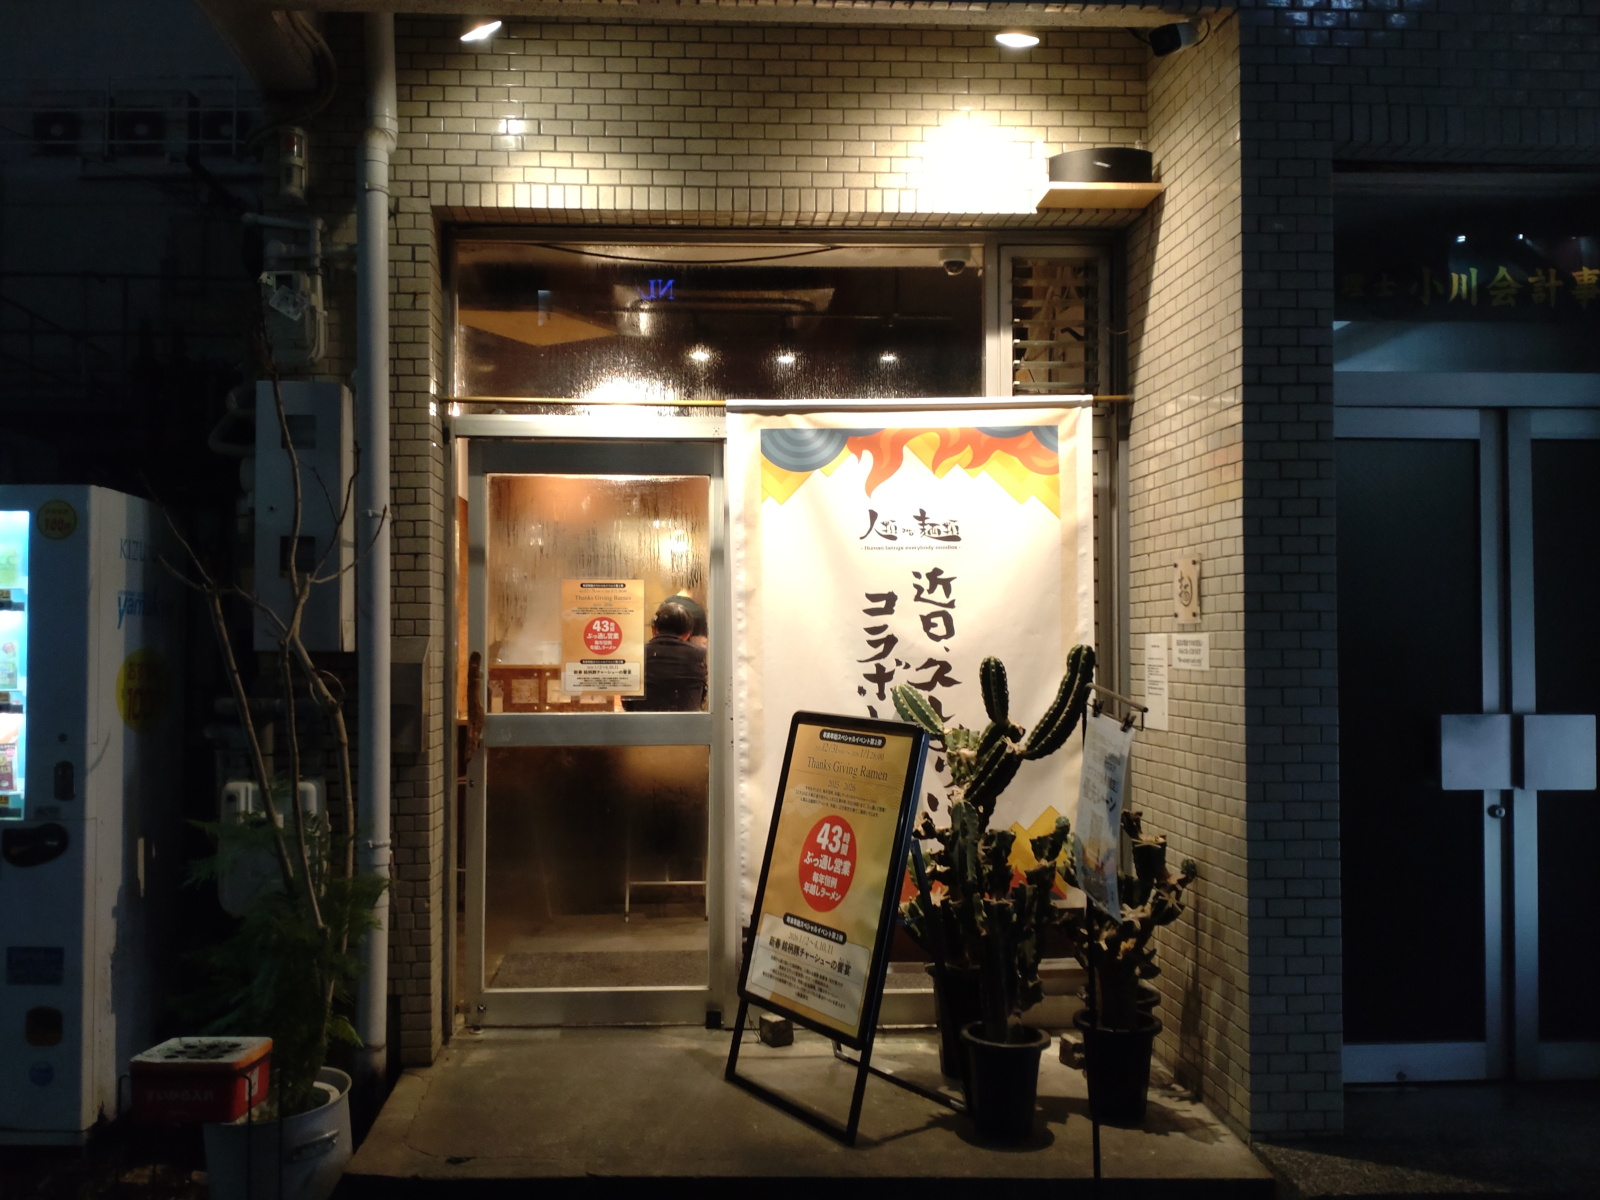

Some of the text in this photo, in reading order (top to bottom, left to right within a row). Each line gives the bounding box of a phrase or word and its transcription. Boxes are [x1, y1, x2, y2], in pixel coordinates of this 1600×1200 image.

[808, 756, 888, 781] Thanks Giving Ramen
[804, 851, 851, 876] ぶっ通し営業
[803, 881, 841, 901] 年越しラーメン
